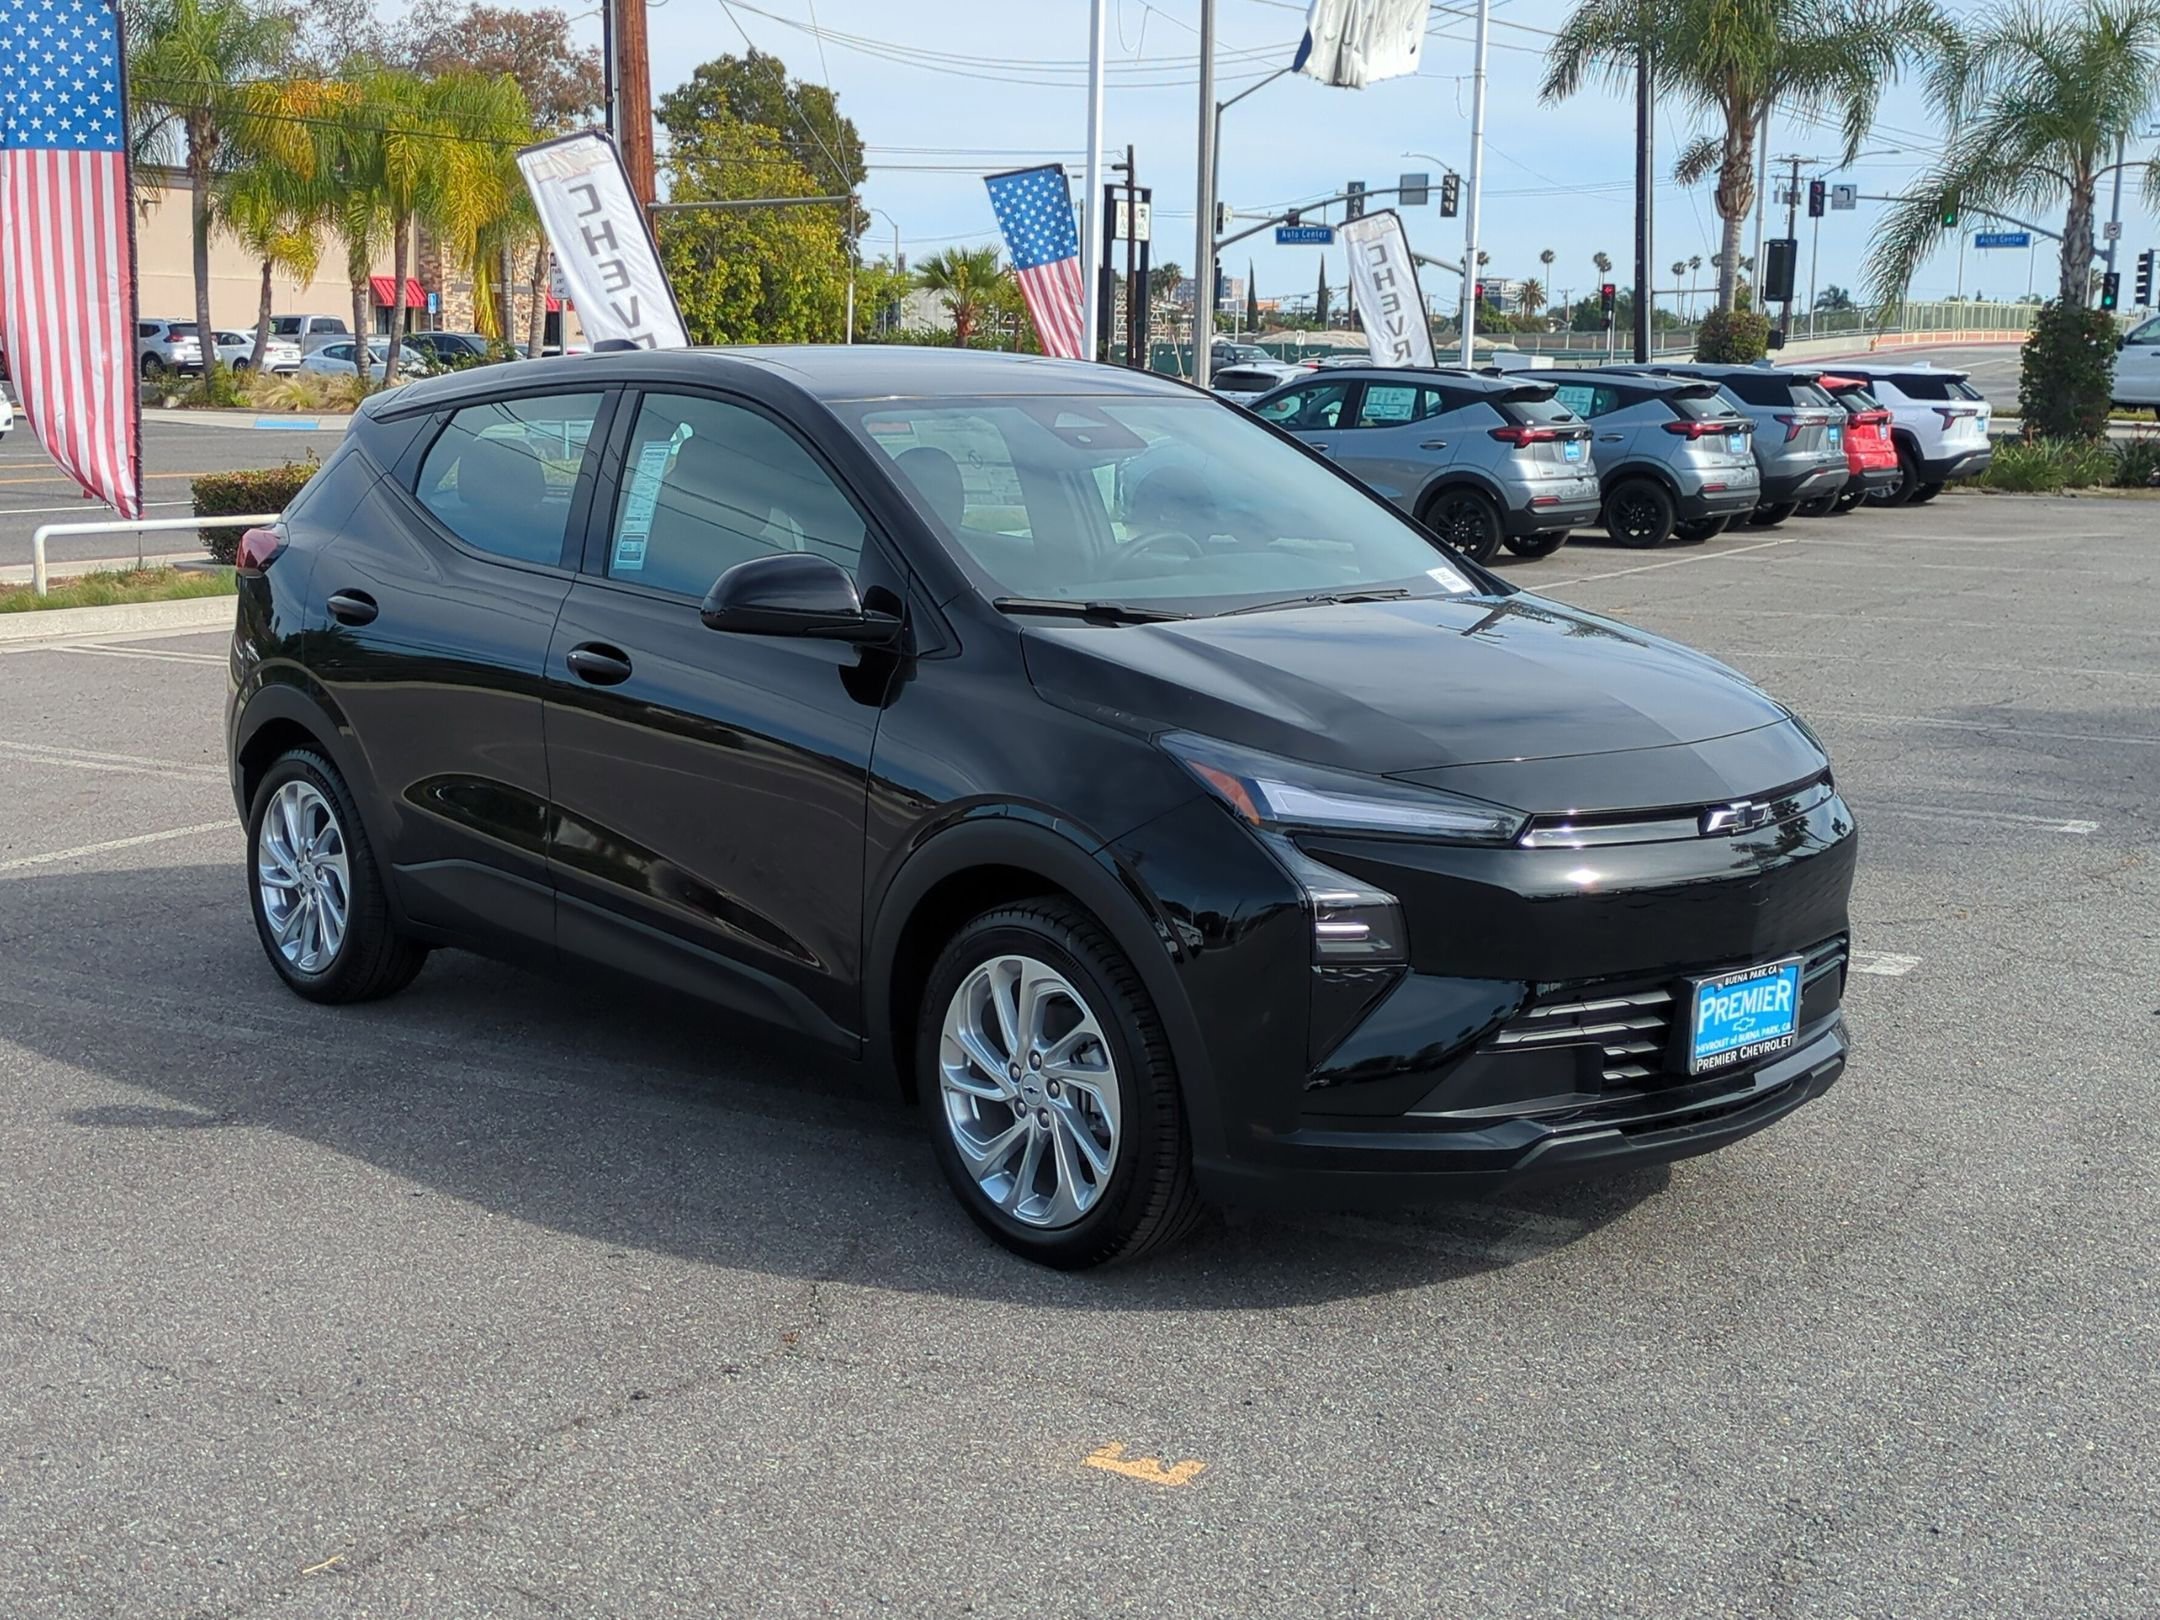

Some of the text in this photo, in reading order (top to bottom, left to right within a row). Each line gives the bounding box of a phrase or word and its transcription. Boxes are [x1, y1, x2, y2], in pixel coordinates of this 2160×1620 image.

[1281, 229, 1327, 239] Auto Center
[1725, 973, 1748, 985] BUENA
[1768, 965, 1777, 975] CA
[1699, 980, 1791, 1033] PREMIER
[1738, 1030, 1760, 1042] BUENA
[1696, 1035, 1792, 1072] PREMIER CHEVROLET
